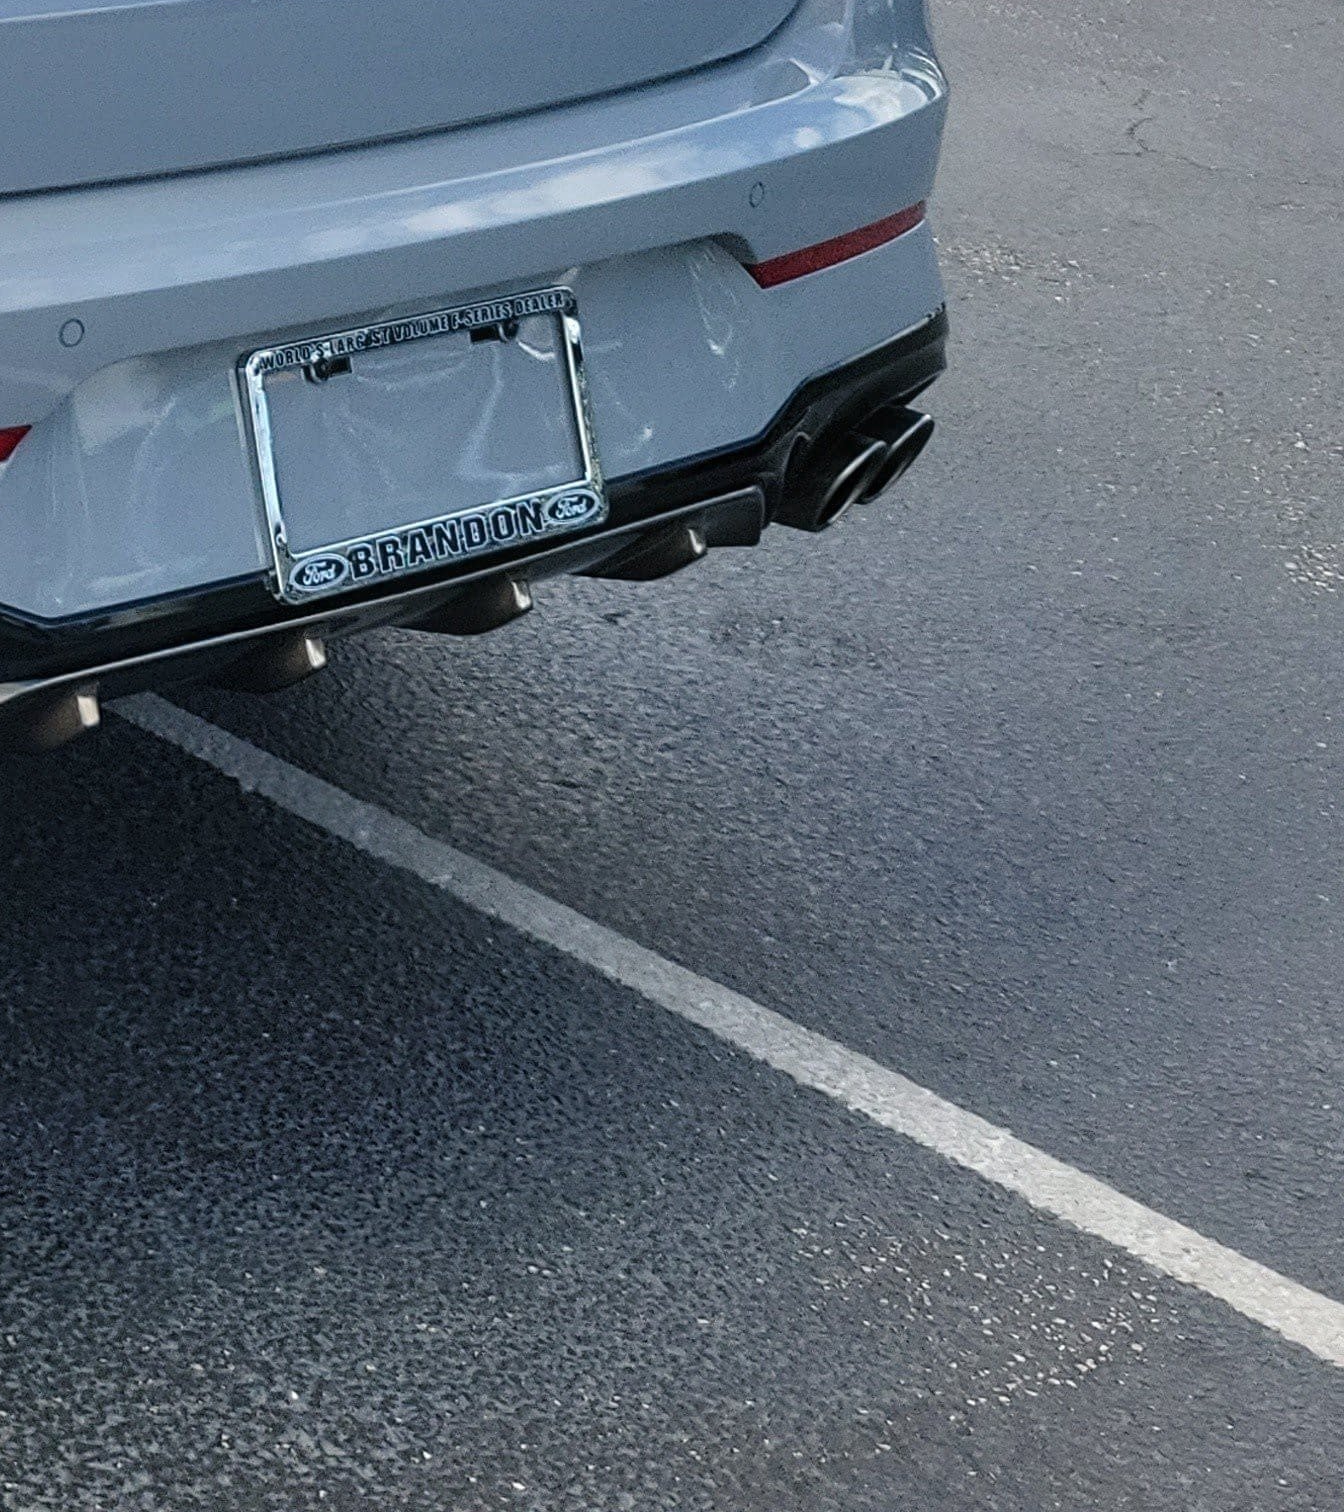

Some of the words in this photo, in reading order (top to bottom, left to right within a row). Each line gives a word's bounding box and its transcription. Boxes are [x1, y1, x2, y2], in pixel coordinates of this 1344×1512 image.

[392, 314, 448, 341] VOLUME
[514, 292, 564, 318] DEALER
[302, 560, 337, 586] Ford
[347, 498, 546, 581] BRANDON
[554, 495, 588, 516] Ford
